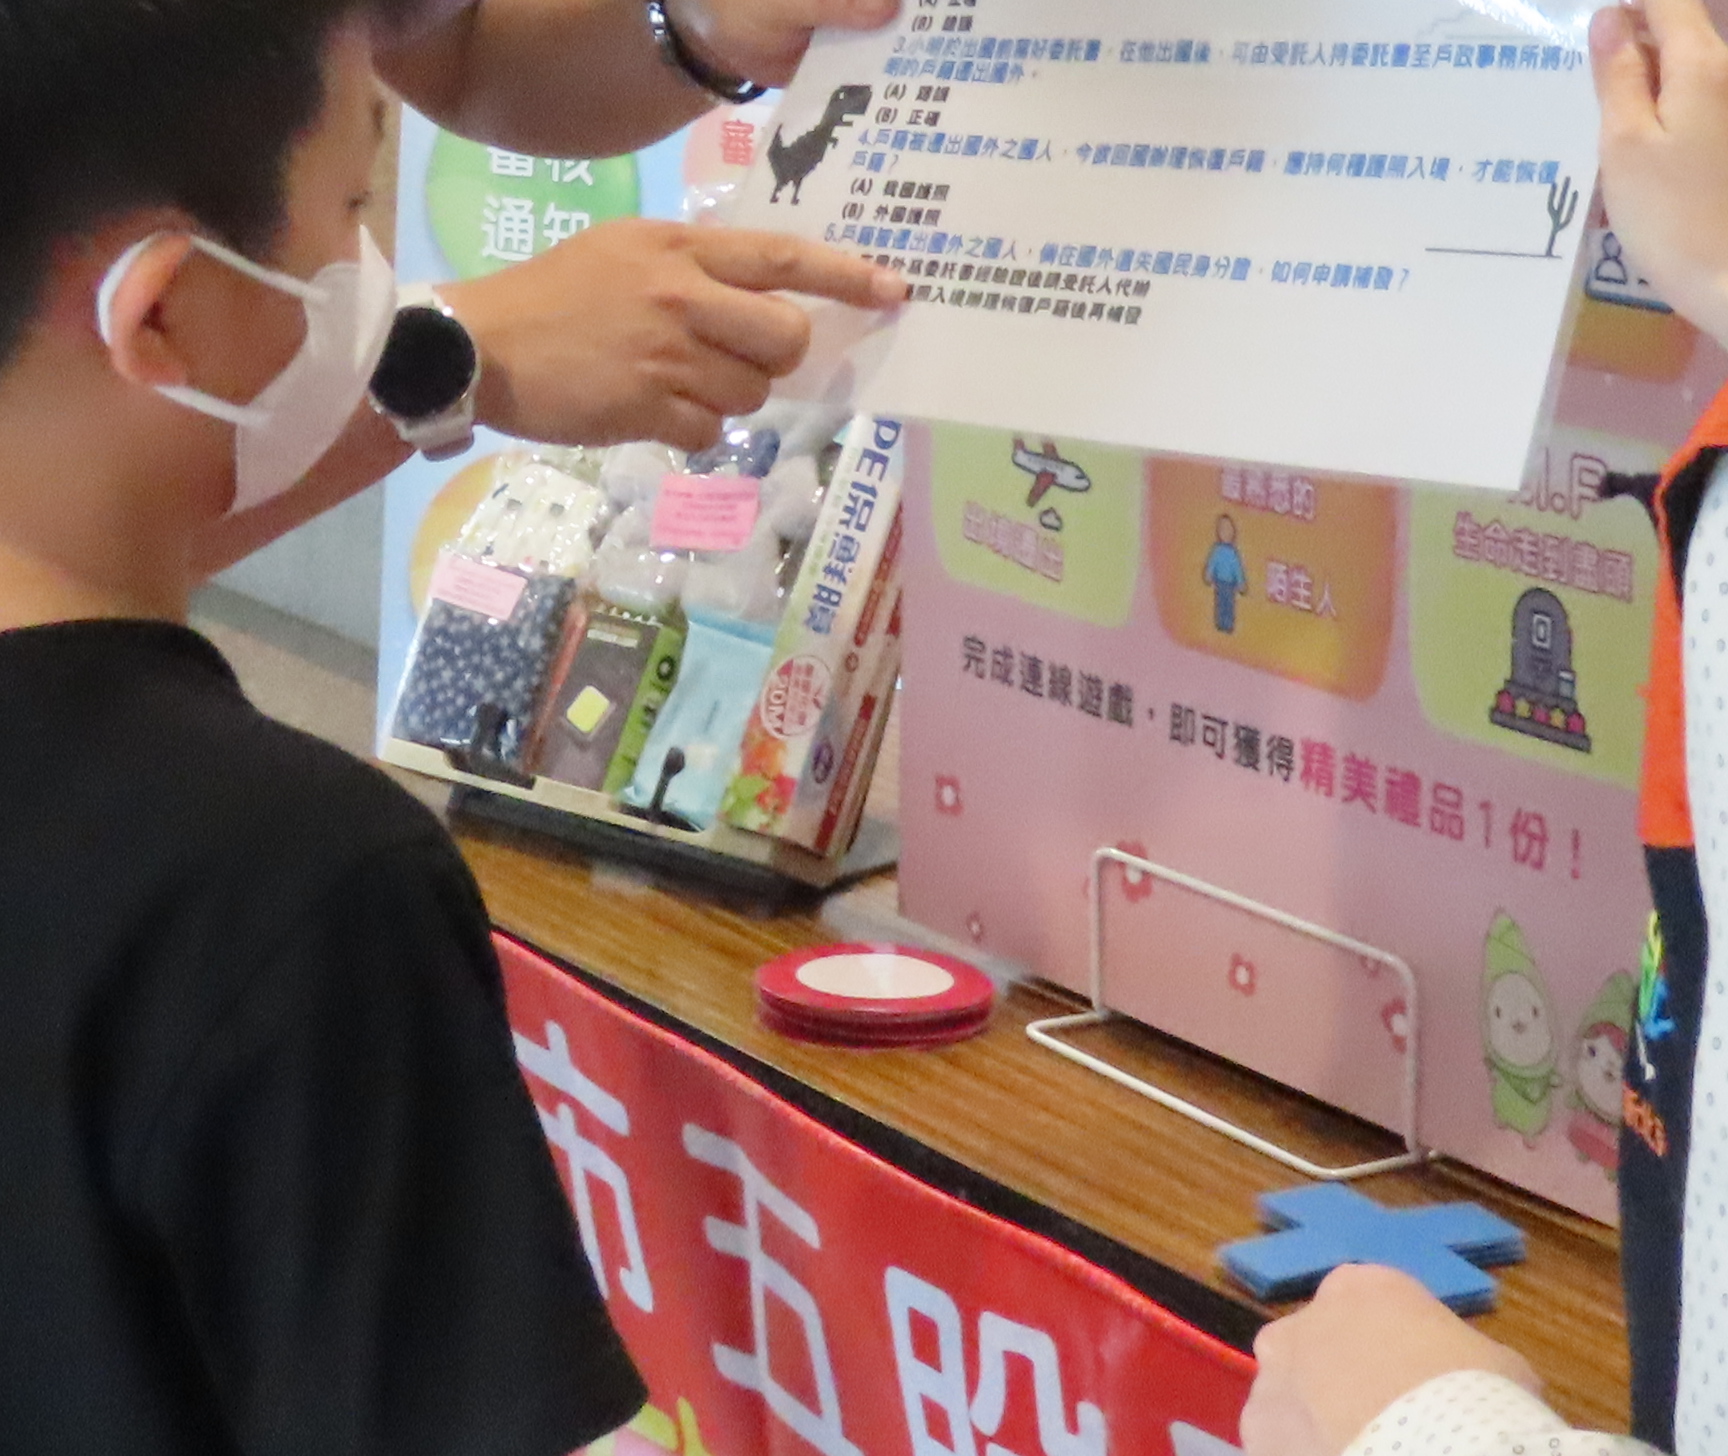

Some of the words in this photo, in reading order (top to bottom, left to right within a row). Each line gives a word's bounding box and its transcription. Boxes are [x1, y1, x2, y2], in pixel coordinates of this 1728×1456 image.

[482, 196, 591, 262] 通知
[803, 417, 903, 636] PE保鮮膜
[1453, 510, 1635, 604] 生命走到盡頭
[511, 1020, 1247, 1456] 市五股
